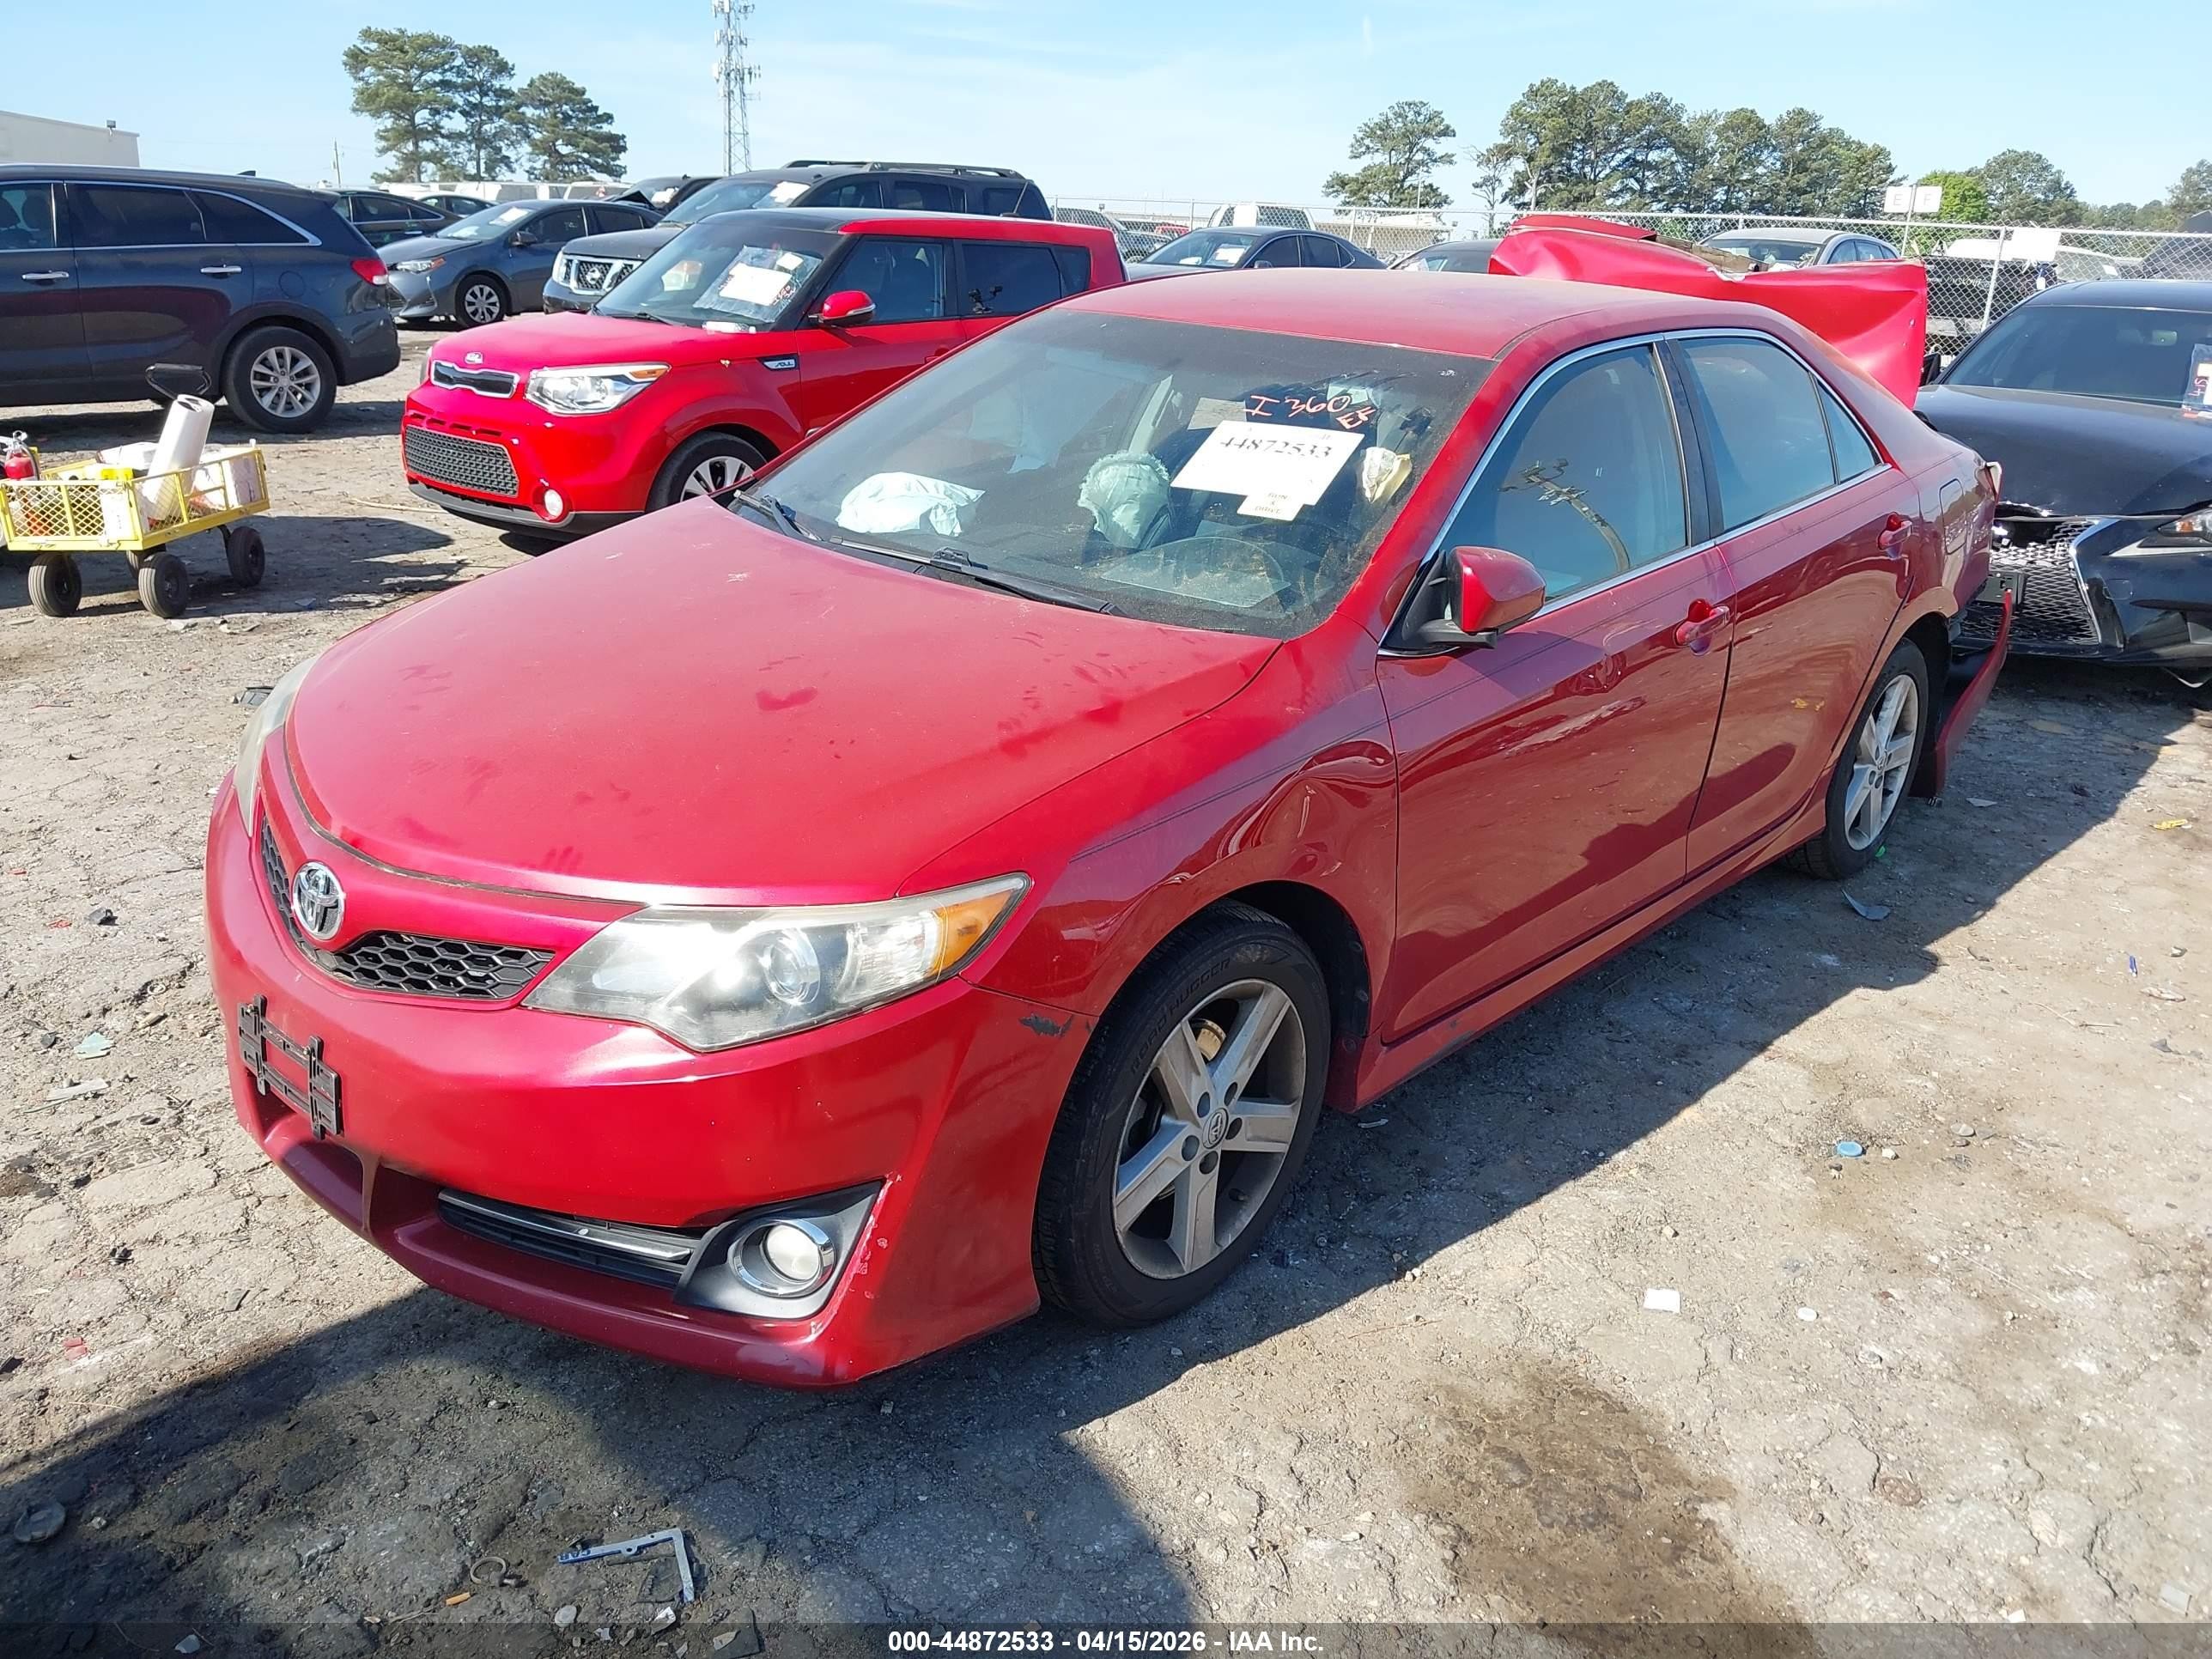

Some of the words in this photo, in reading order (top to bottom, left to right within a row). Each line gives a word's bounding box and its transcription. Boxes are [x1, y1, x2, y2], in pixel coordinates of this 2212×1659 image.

[1893, 193, 1904, 206] E
[1923, 193, 1933, 206] F
[1219, 436, 1333, 459] 44872533
